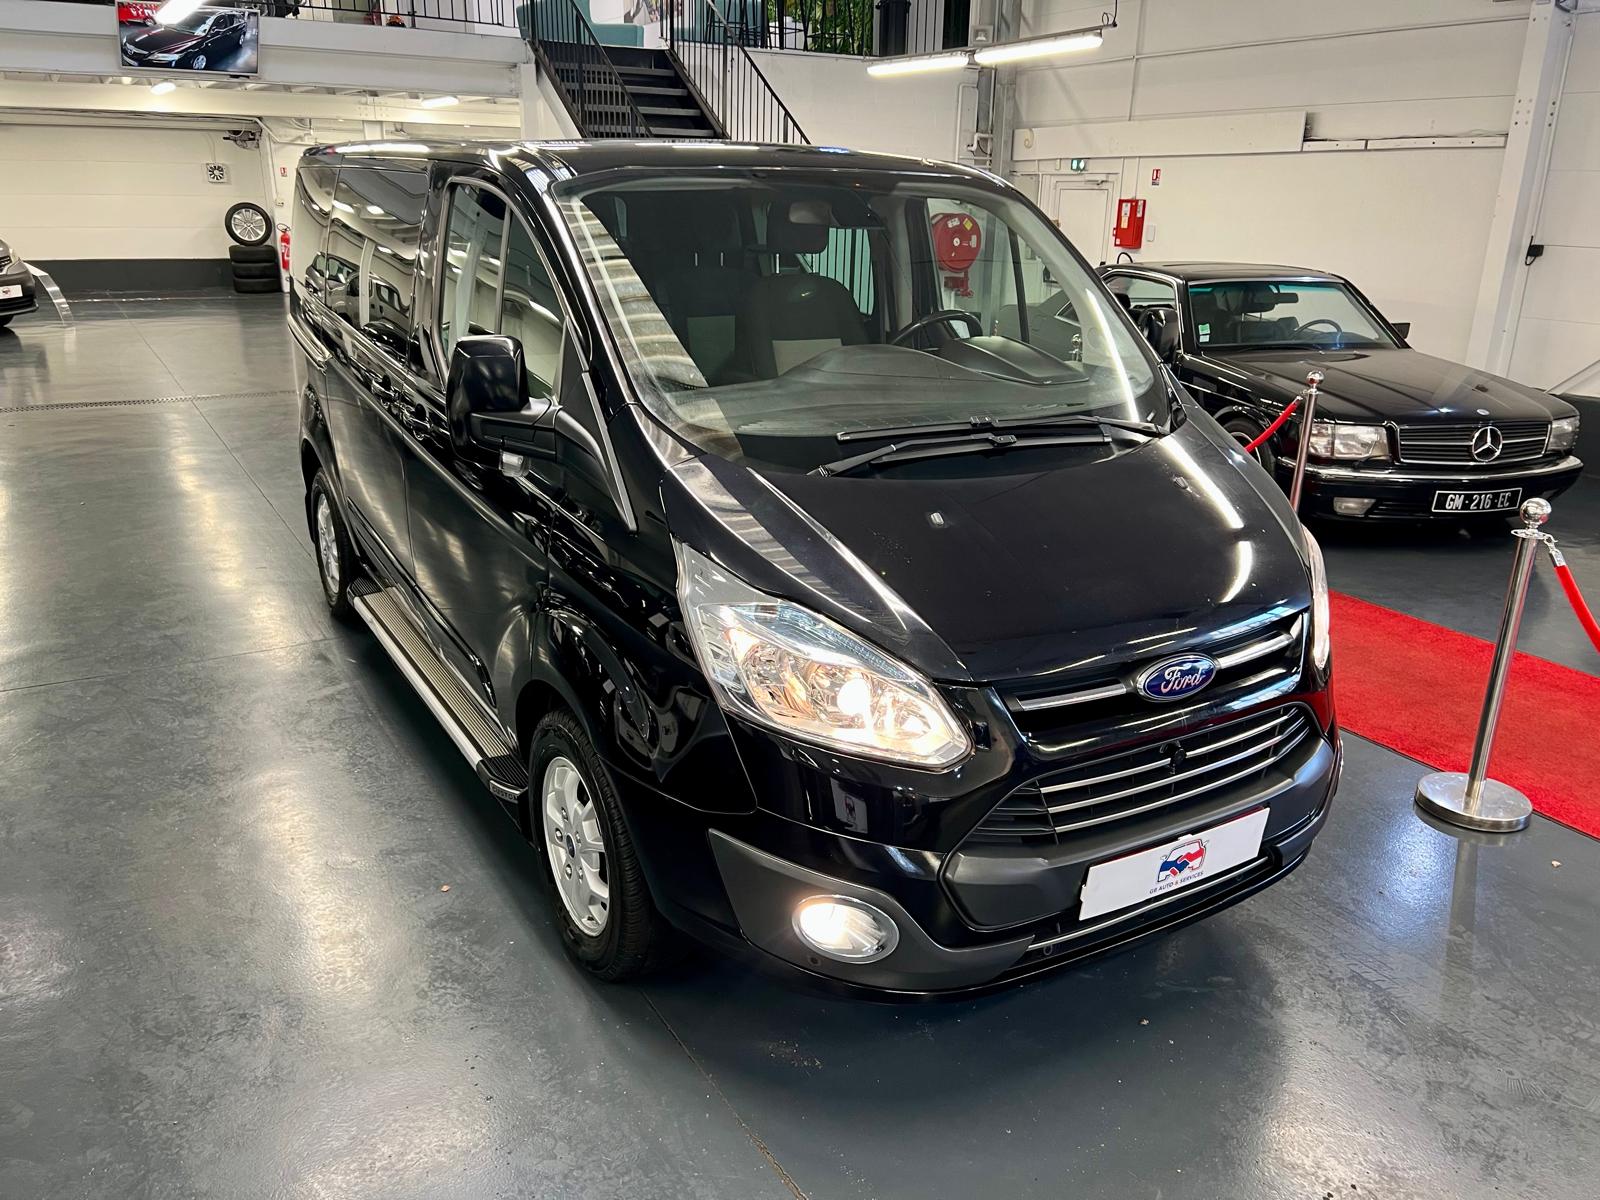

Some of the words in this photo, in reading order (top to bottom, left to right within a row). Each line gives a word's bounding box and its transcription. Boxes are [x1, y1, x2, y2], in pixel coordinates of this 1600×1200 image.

[1160, 662, 1206, 694] Ford
[1158, 881, 1174, 891] AUTO
[1180, 870, 1204, 883] SERVICES
